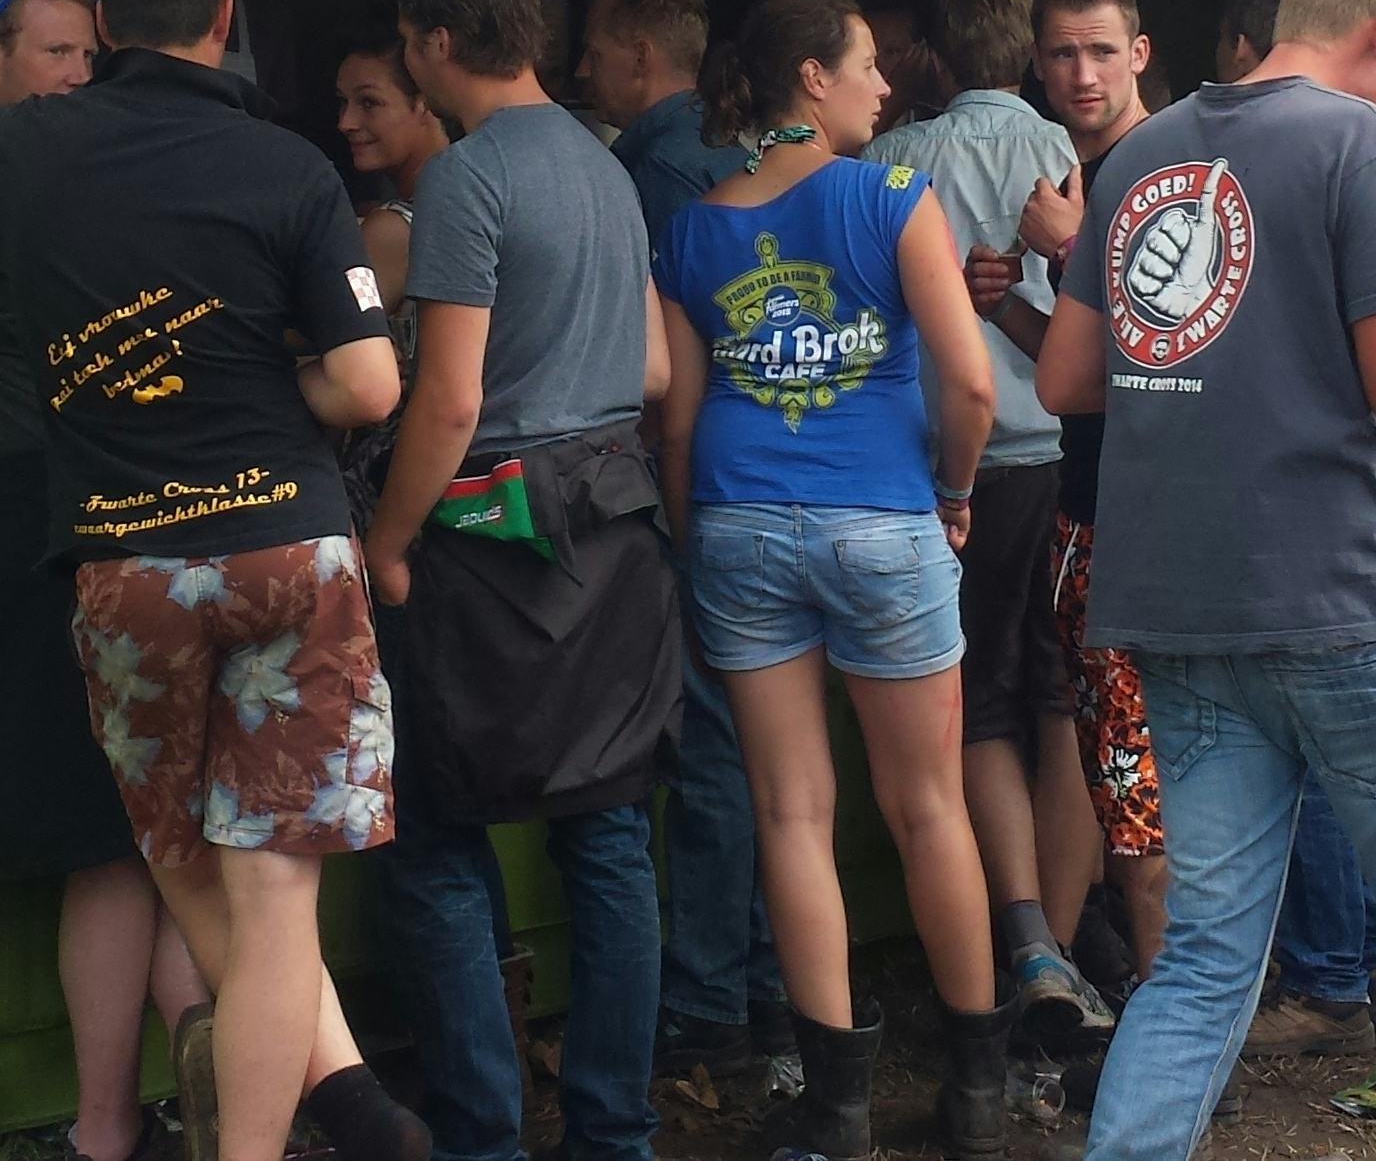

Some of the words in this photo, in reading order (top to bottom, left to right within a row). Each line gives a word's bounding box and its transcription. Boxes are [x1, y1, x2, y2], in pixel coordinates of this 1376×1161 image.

[1130, 172, 1197, 213] GOED!
[726, 281, 756, 306] PROUD
[756, 276, 769, 289] TO
[769, 273, 783, 285] BE
[783, 271, 790, 283] A
[1176, 265, 1244, 354] ZWARTE
[1220, 190, 1248, 262] CROSS
[164, 297, 225, 334] naar
[791, 312, 885, 364] Brok
[1177, 377, 1203, 393] 2014
